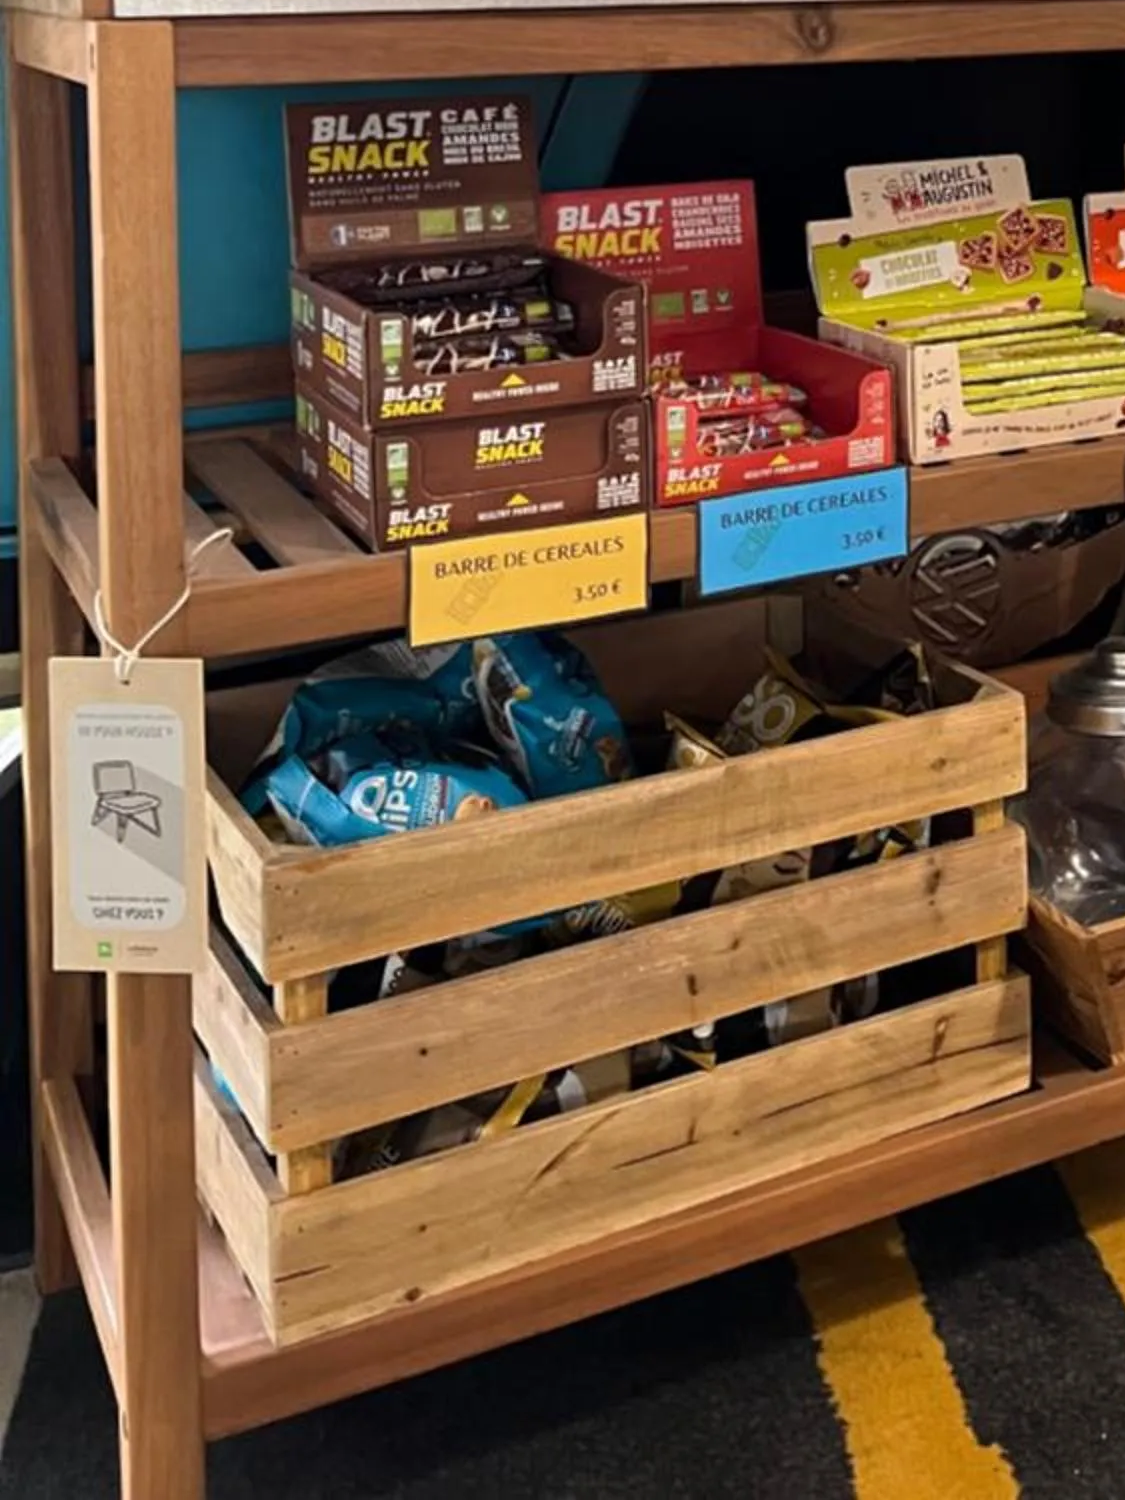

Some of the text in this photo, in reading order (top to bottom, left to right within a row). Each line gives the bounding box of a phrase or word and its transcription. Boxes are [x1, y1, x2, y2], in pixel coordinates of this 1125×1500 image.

[311, 111, 432, 143] BLAST
[308, 140, 431, 174] SNACK
[557, 199, 664, 232] BLAST
[555, 227, 663, 260] SNACK
[383, 382, 448, 402] BLAST
[380, 397, 446, 419] SNACK
[478, 422, 546, 447] BLAST
[475, 440, 544, 465] SNACK
[667, 463, 723, 483] BLAST
[664, 478, 721, 498] SNACK
[388, 503, 454, 526] BLAST
[720, 485, 888, 530] BARRE DE CEREALES
[385, 519, 450, 543] SNACK
[841, 531, 874, 550] 3.50
[434, 536, 625, 580] BARRE DE CEREALES
[573, 583, 608, 603] 3.50
